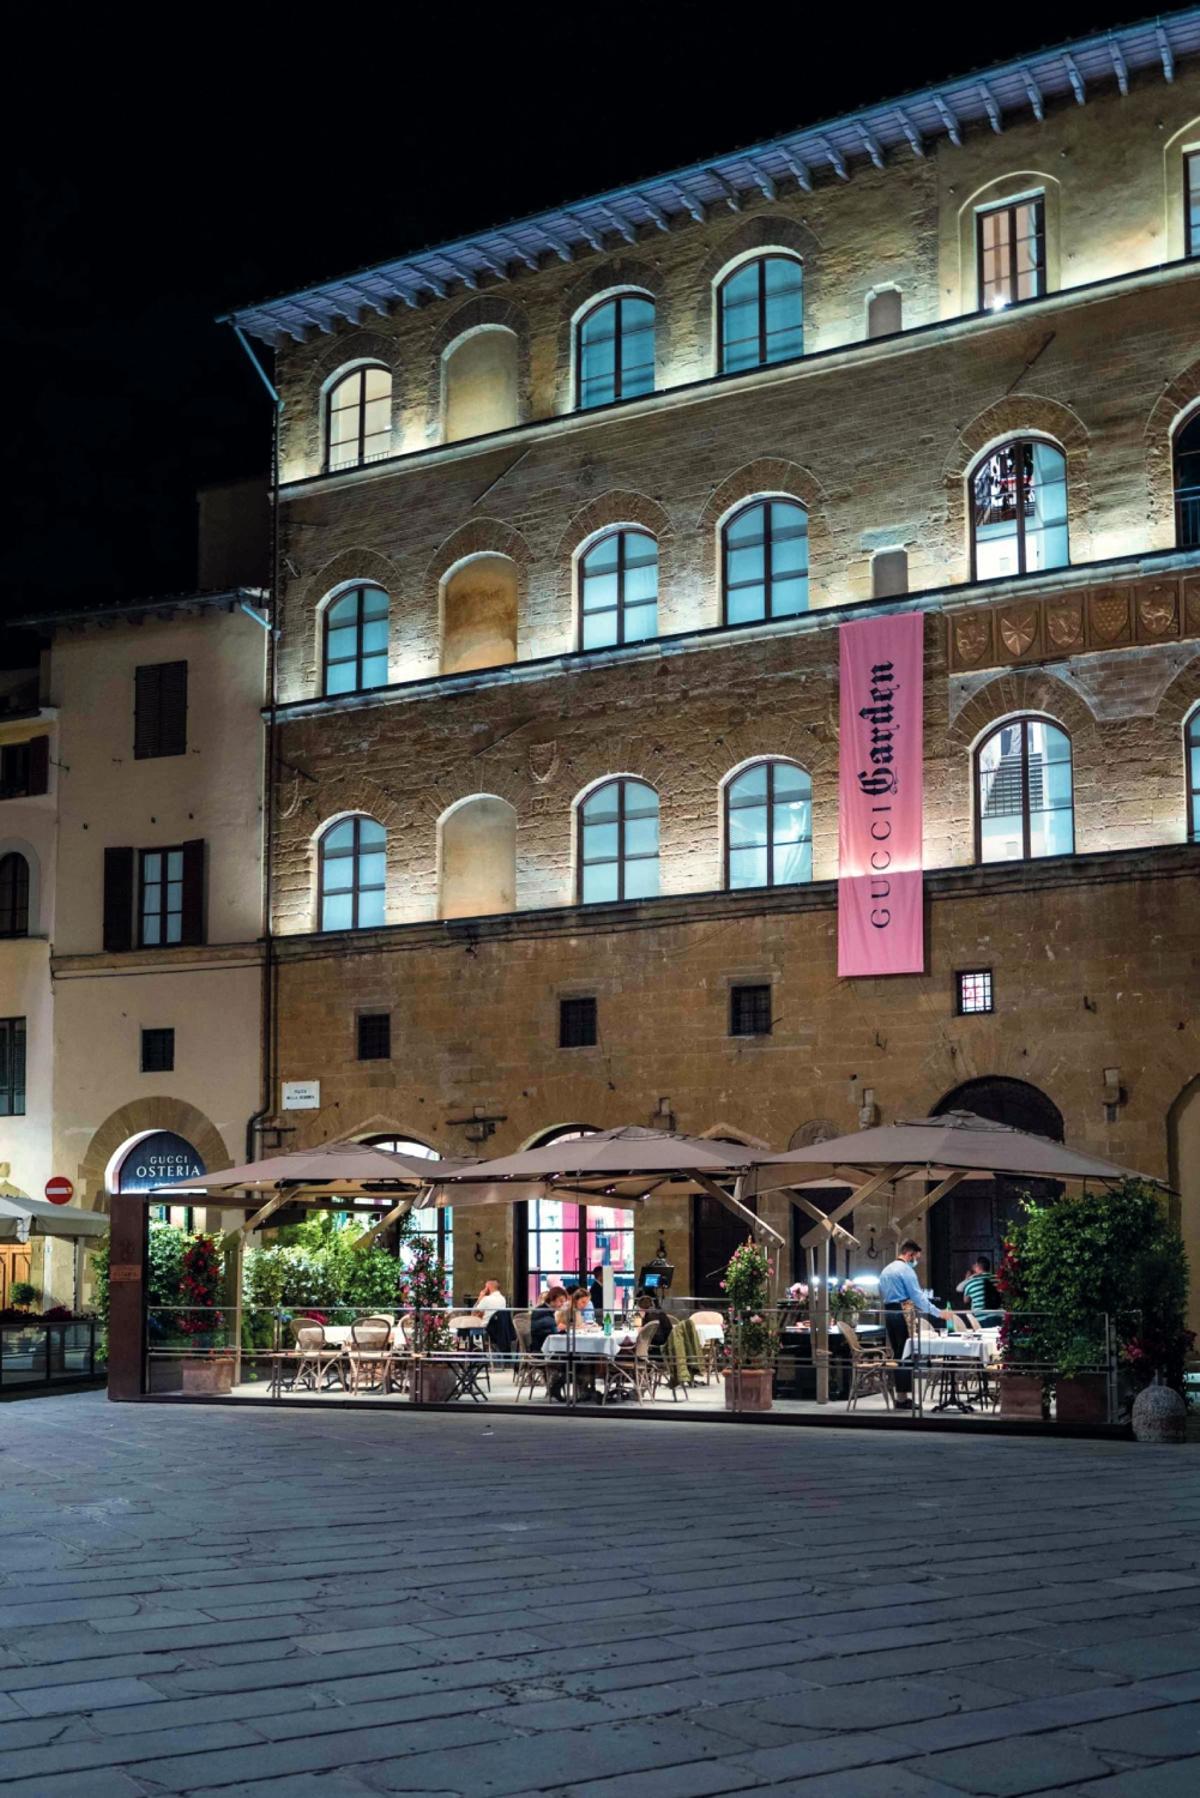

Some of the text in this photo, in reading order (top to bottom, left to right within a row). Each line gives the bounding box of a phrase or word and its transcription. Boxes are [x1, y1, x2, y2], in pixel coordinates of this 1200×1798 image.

[857, 660, 901, 929] GUCCI Garden
[150, 1155, 188, 1165] GUCCI
[136, 1165, 200, 1178] OSTERIA
